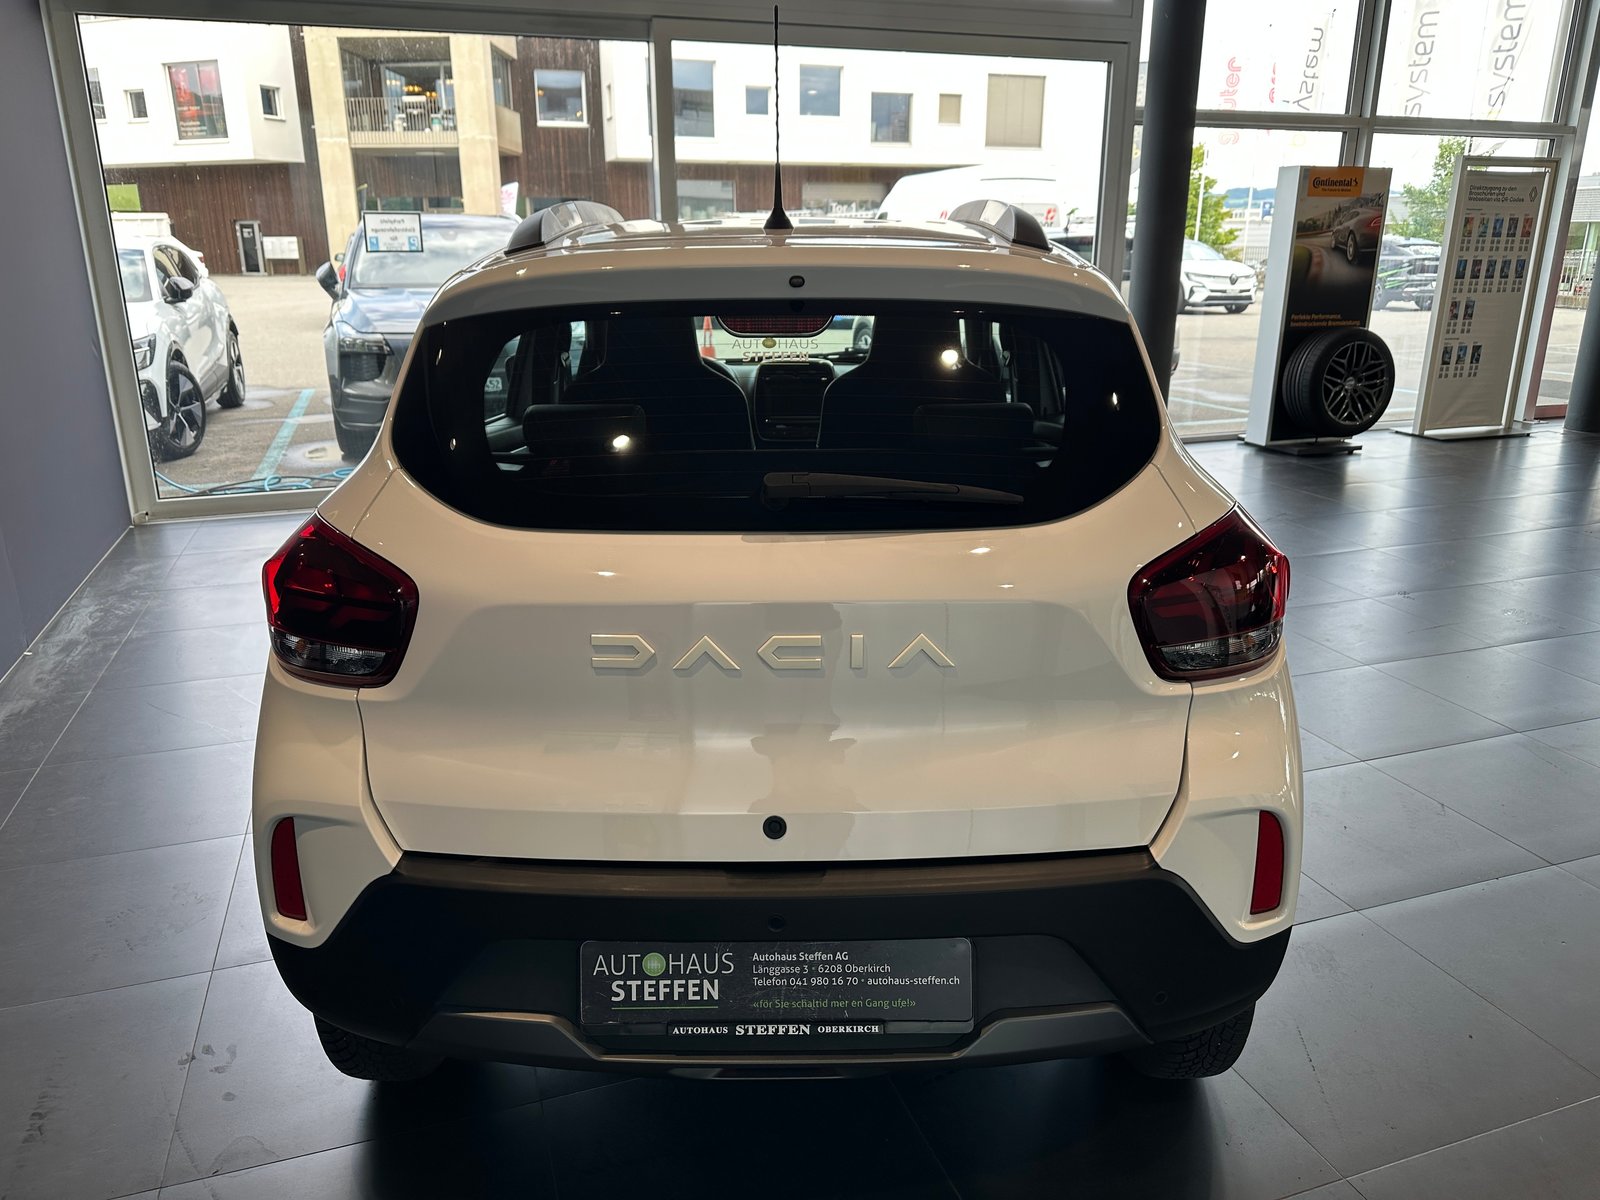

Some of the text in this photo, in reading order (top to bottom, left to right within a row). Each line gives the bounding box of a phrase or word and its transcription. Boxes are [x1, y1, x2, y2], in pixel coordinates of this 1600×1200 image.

[1312, 176, 1352, 188] Continental
[742, 351, 809, 361] STEFFEN
[590, 633, 956, 670] DACIA
[753, 952, 848, 961] Autohaus Steffen AG
[753, 964, 891, 975] Länggasse 3 6208 Oberkirch
[753, 975, 960, 986] Telefon 041 980 16 70 autohaus-steffen.ch
[611, 979, 719, 1001] STEFFEN
[775, 999, 789, 1009] Sie
[791, 998, 828, 1008] schaltid
[830, 1000, 849, 1008] mer
[851, 1000, 863, 1008] en
[865, 998, 889, 1009] Gang
[672, 1024, 880, 1036] AUTOHAUS STEFFEN OBERKIRCH
